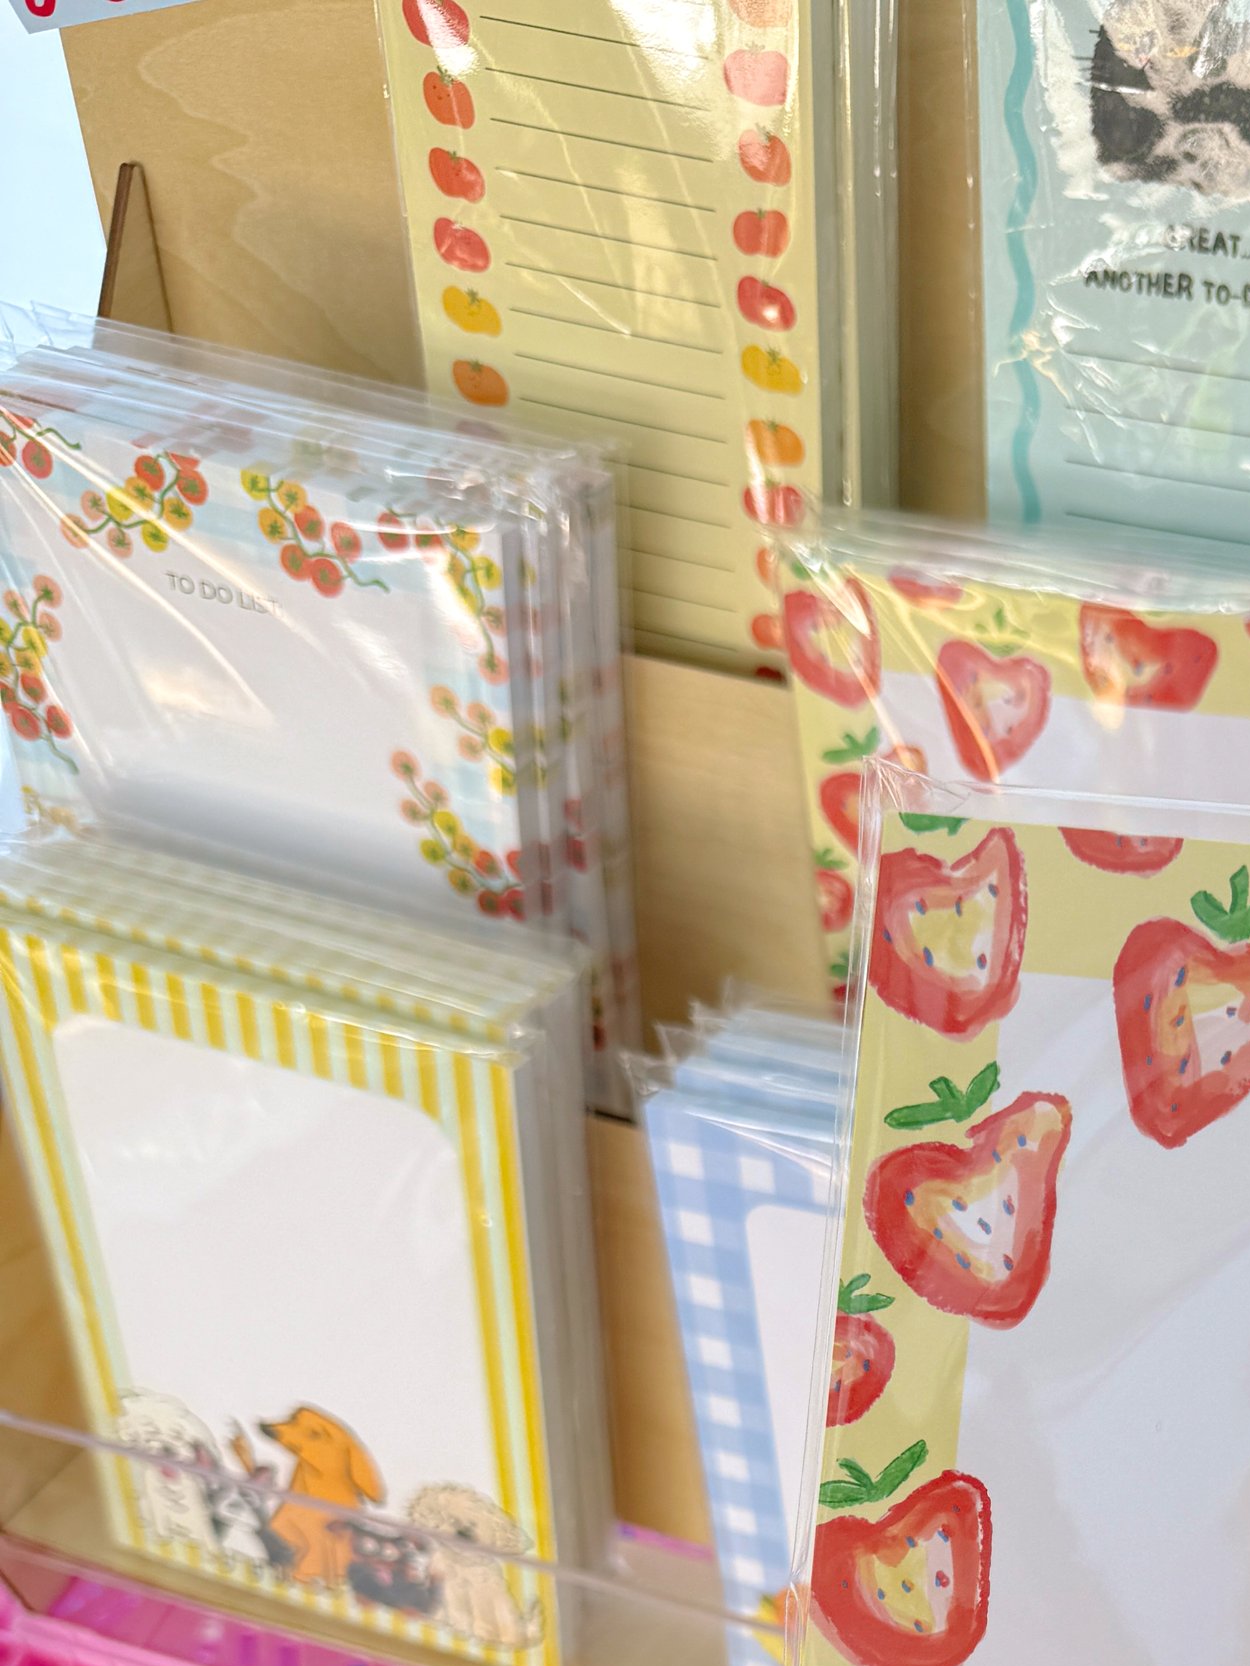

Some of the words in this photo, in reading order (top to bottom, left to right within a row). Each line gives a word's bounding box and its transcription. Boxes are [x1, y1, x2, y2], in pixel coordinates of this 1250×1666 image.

[1085, 269, 1194, 300] ANOTHER
[164, 570, 195, 595] TO
[200, 579, 233, 604] DO
[239, 591, 281, 615] LIST
